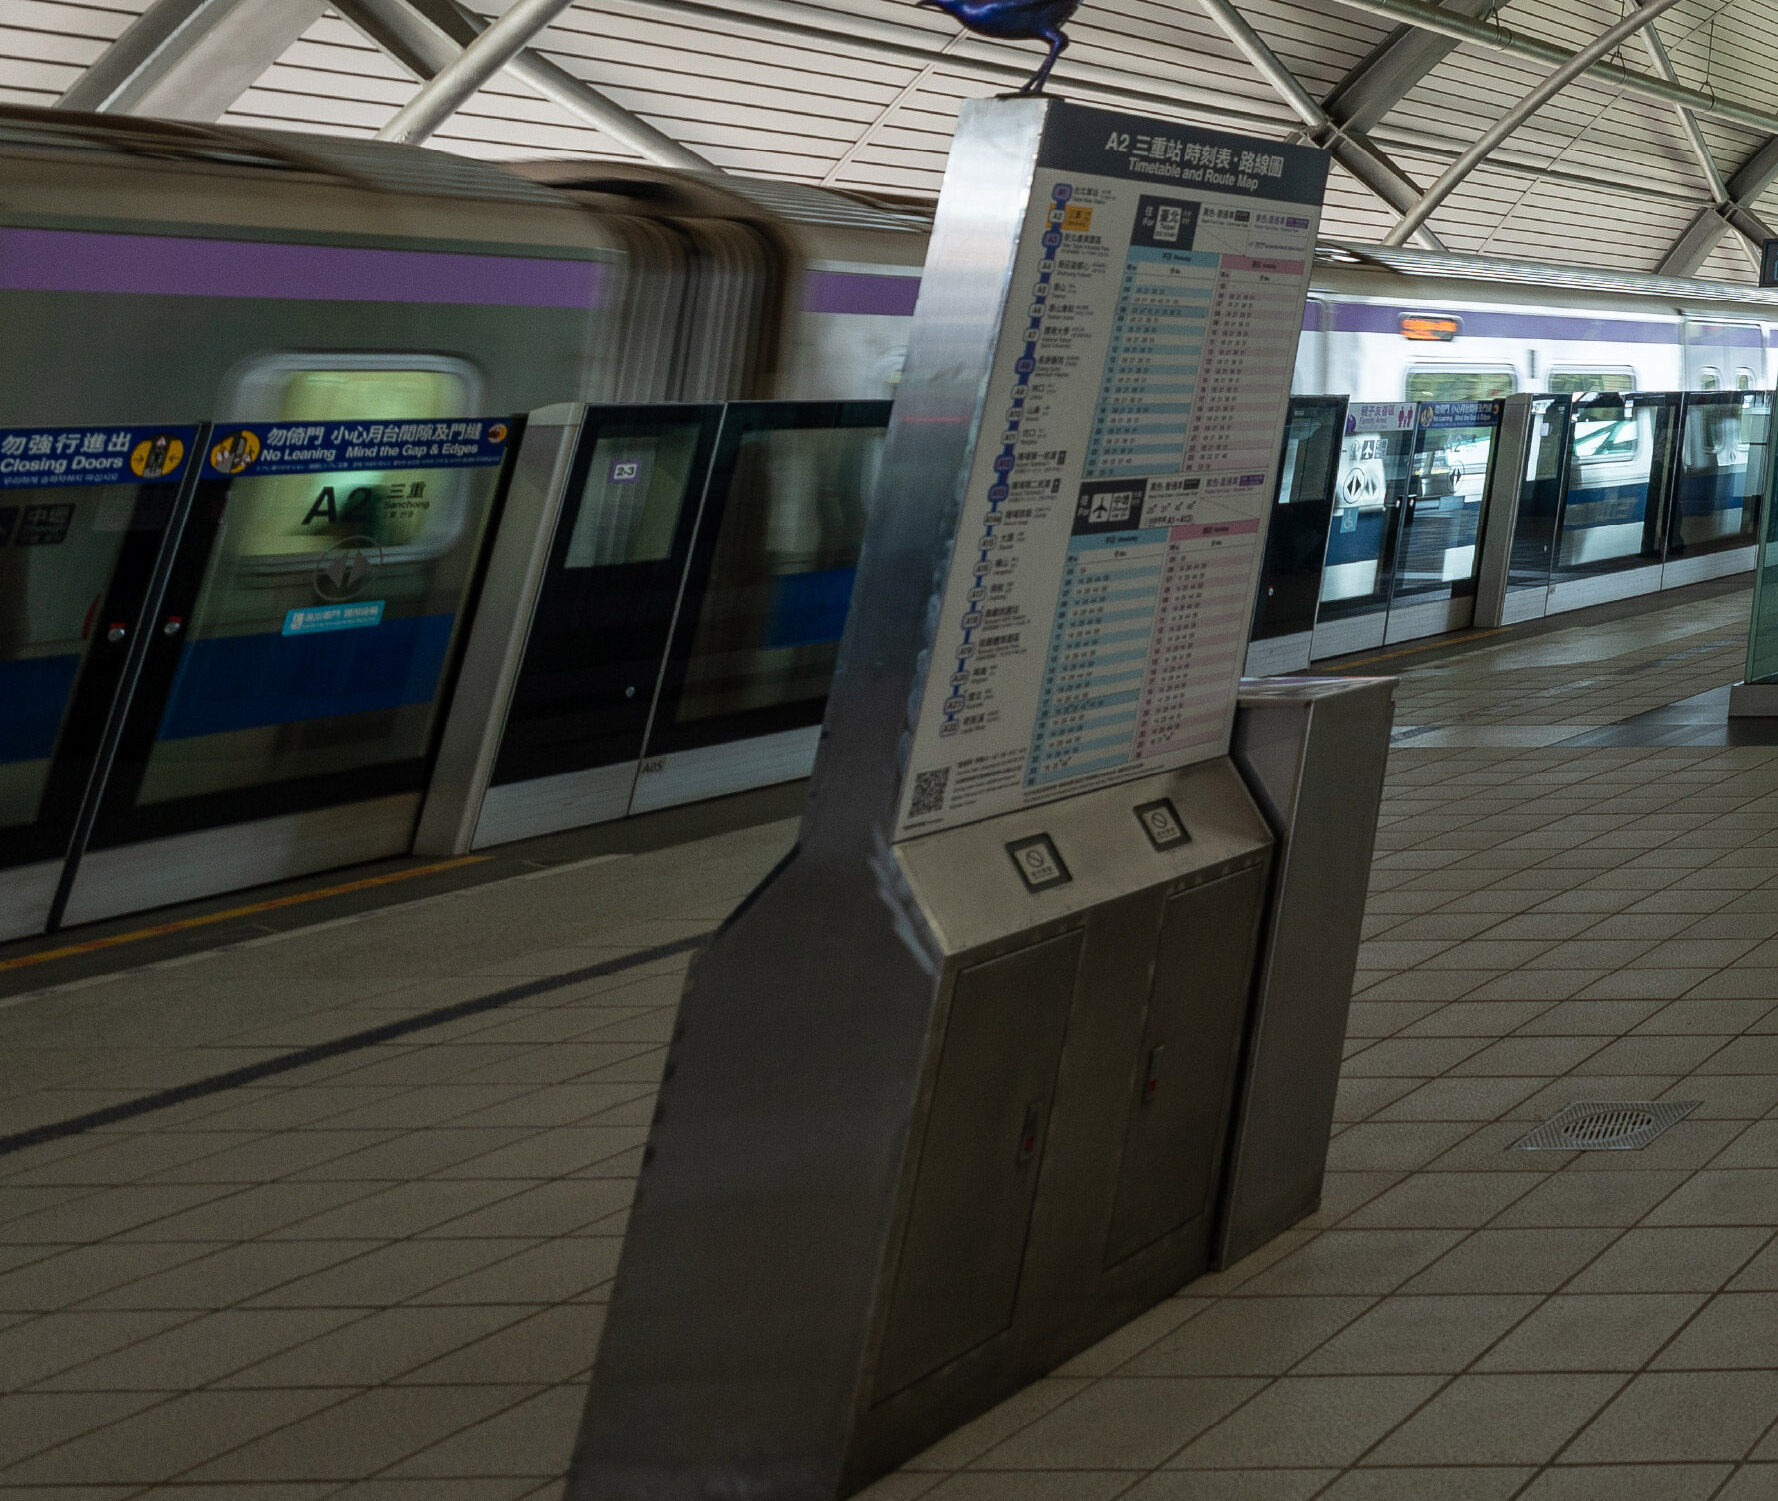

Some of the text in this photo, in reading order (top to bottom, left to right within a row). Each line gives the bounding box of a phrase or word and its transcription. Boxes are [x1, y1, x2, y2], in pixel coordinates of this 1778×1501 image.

[1105, 131, 1130, 152] A2
[1131, 134, 1183, 162] 三重站
[1128, 156, 1259, 191] Timetable and Route Map
[1, 431, 132, 456] 勿強行進出
[267, 422, 483, 446] 勿倚門 小心月台間隙及門縫
[260, 449, 337, 462] No Leaning
[346, 442, 479, 458] Mind the Gap & Edges
[0, 456, 124, 473] Closing Doors
[386, 481, 427, 499] 三重
[301, 485, 373, 525] A2
[384, 500, 430, 509] Sanchong
